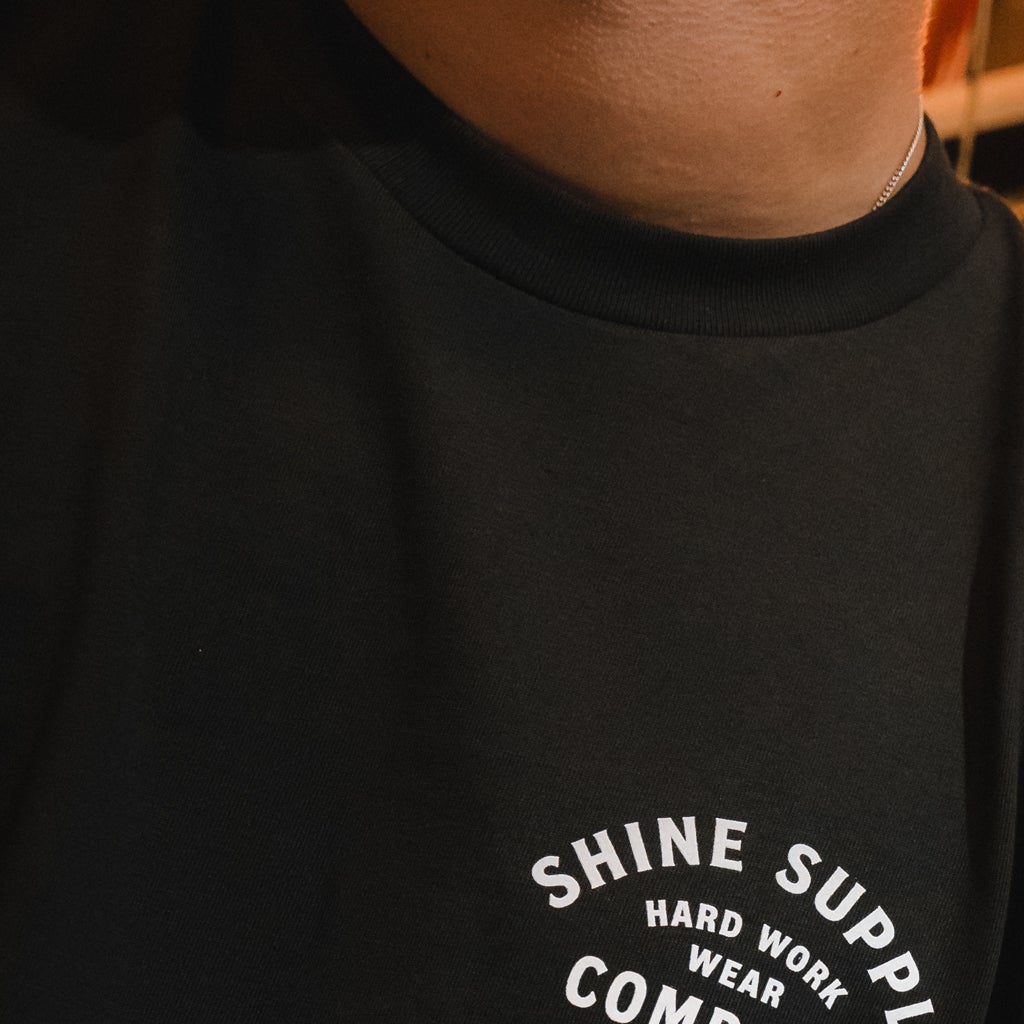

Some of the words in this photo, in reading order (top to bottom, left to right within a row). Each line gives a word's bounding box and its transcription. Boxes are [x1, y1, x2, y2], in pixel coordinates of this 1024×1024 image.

[531, 816, 747, 909] SHINE
[645, 899, 743, 938] HARD
[758, 923, 848, 1010] WORK
[689, 944, 785, 1009] WEAR
